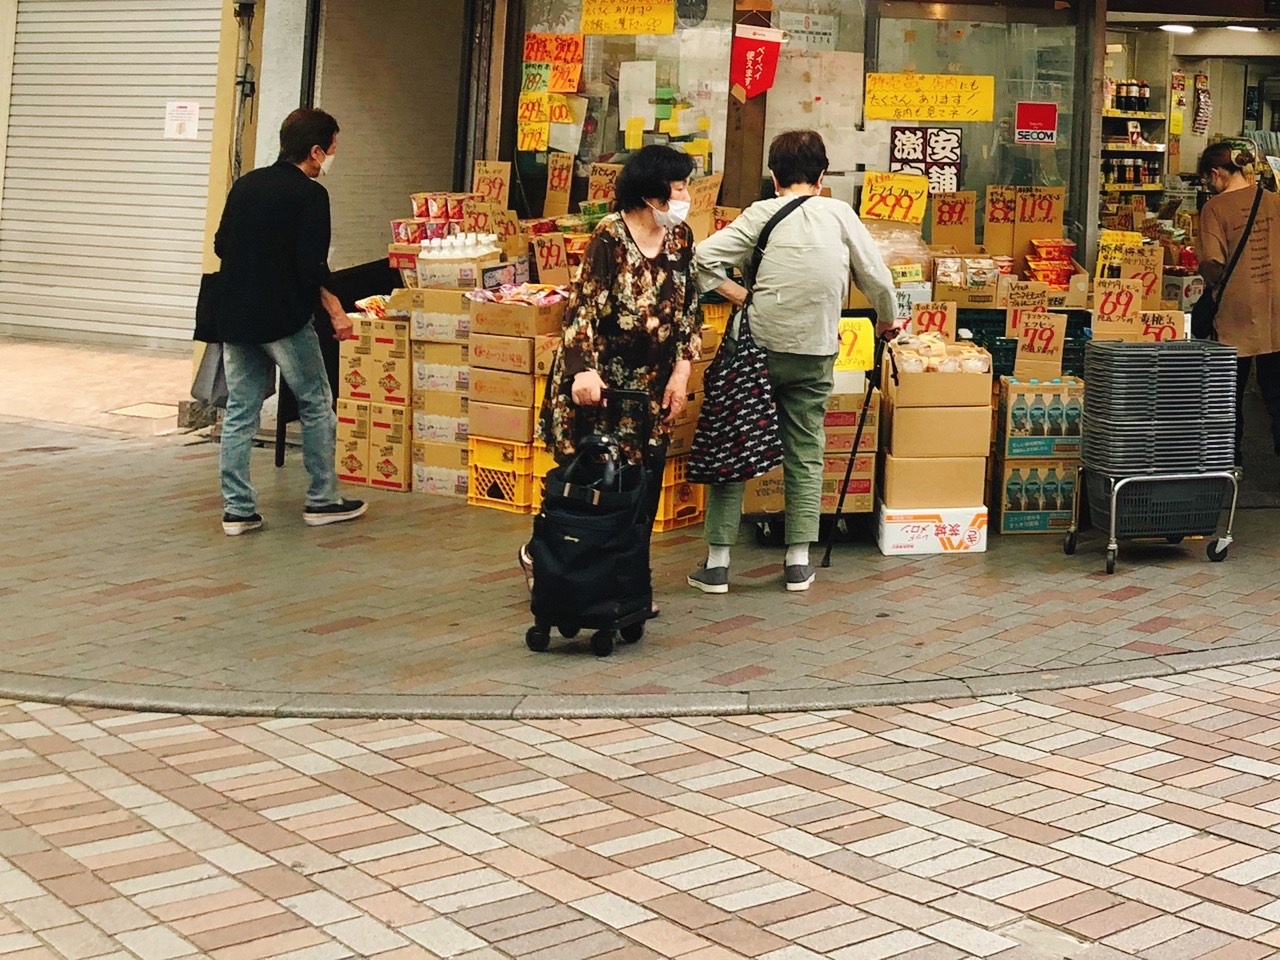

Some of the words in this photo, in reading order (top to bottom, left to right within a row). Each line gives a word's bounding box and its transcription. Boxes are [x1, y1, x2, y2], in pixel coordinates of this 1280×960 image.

[754, 45, 766, 81] ペイペイ
[869, 93, 912, 106] たくさん
[893, 129, 961, 163] 激安
[1017, 130, 1054, 141] SECOM
[865, 192, 914, 220] 299
[937, 202, 967, 224] 89
[1020, 197, 1053, 221] 119
[538, 243, 562, 263] 99
[1099, 289, 1134, 318] 69
[843, 321, 862, 331] BIG
[917, 310, 947, 333] 99
[1023, 328, 1055, 354] 79
[900, 524, 931, 534] メロン
[934, 523, 961, 537] 茨城
